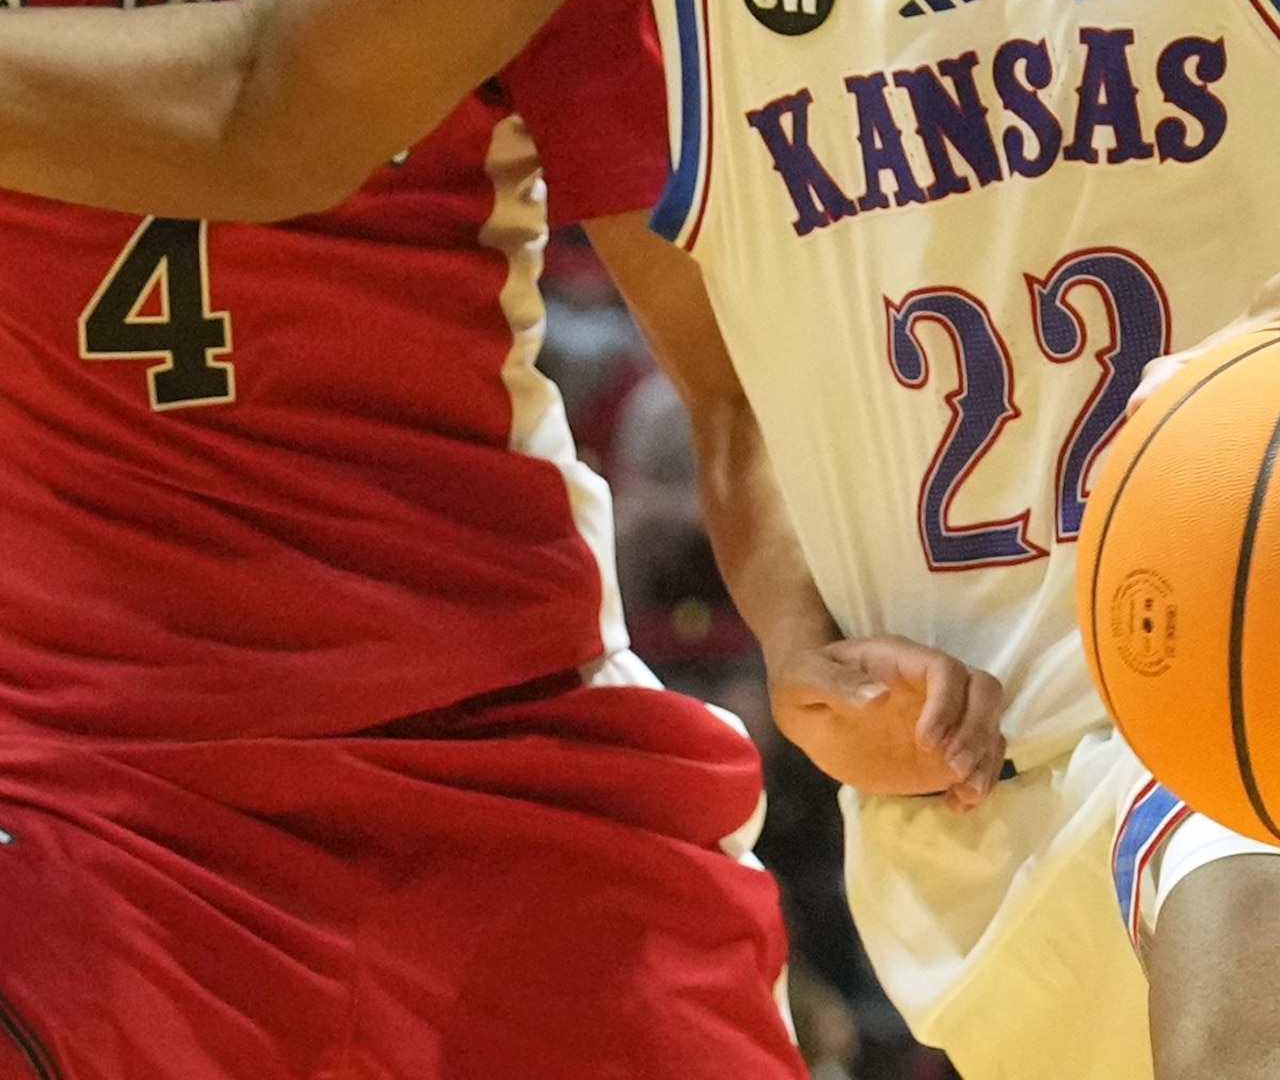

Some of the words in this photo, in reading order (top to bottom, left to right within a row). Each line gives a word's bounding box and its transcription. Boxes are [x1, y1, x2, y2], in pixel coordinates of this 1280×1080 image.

[744, 27, 1228, 237] KANSAS
[78, 215, 236, 411] 4
[883, 245, 1172, 572] 22
